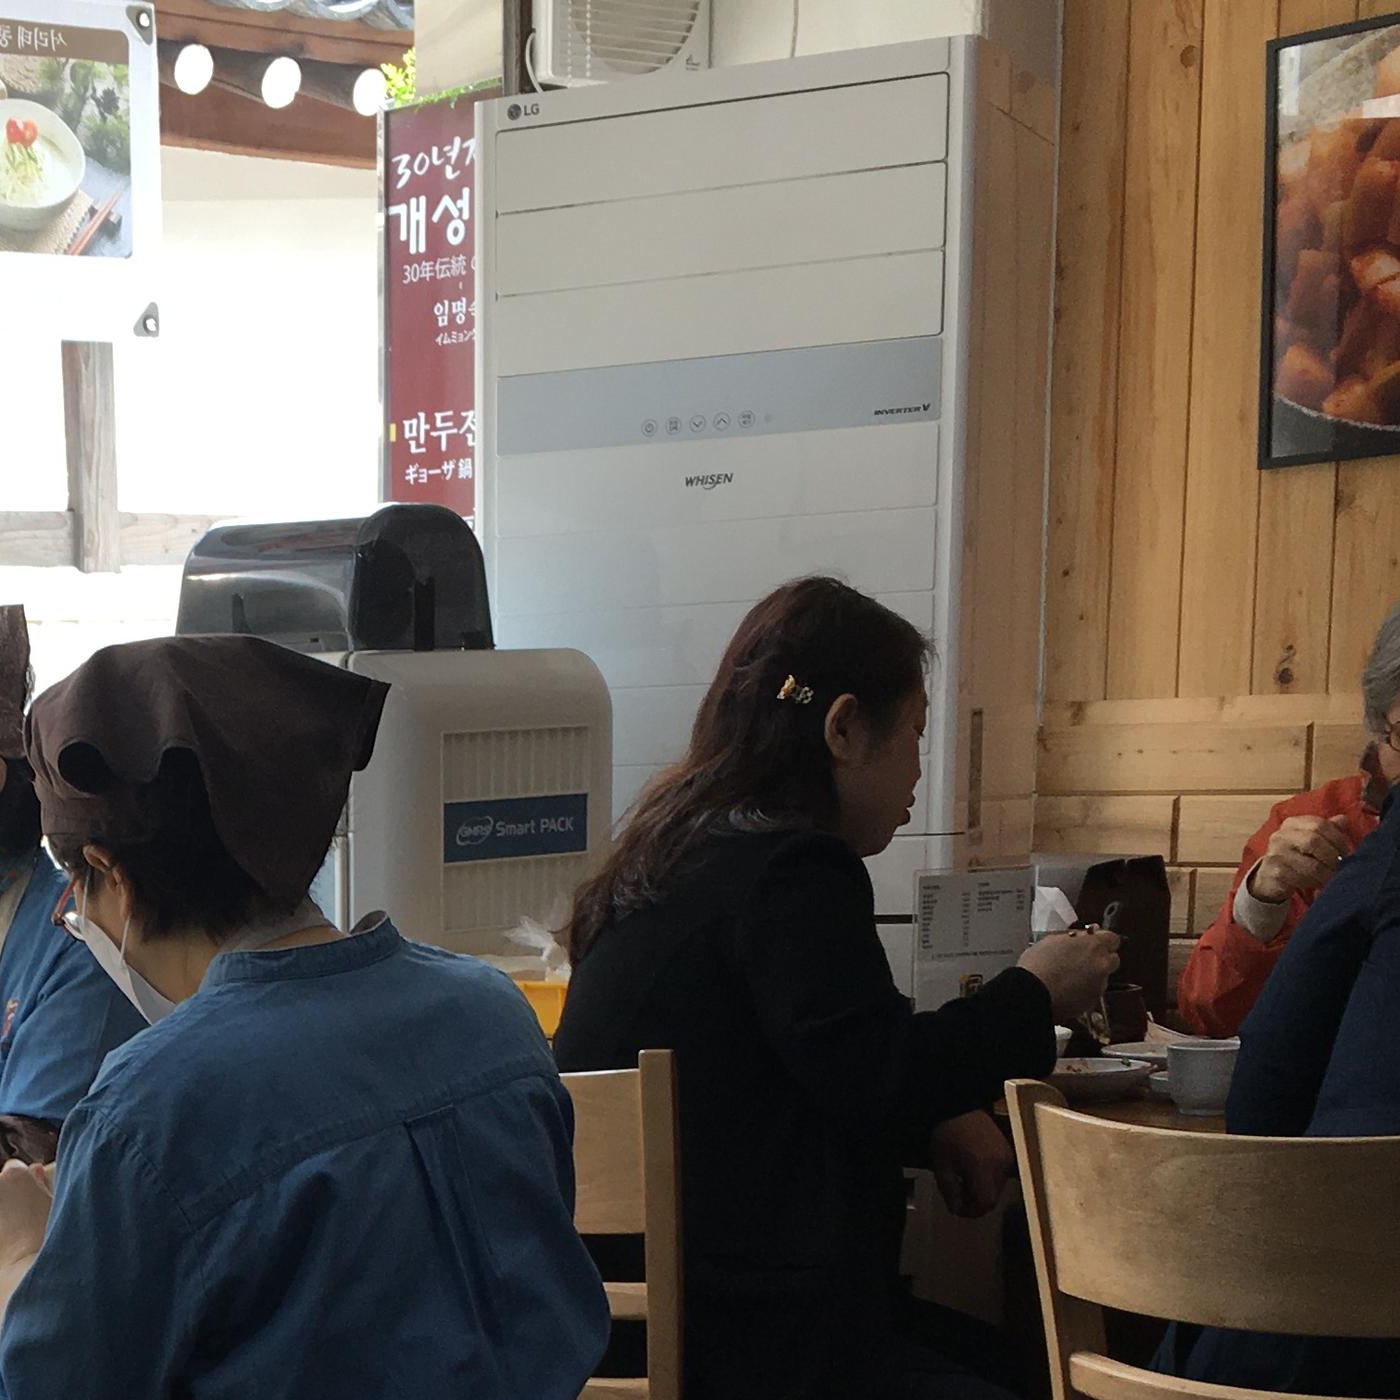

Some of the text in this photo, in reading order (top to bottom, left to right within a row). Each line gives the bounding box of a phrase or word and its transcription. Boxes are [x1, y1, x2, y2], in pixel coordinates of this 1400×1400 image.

[523, 103, 540, 116] LG
[388, 187, 470, 255] 개성
[402, 254, 467, 285] 30年伝統
[685, 473, 733, 490] WHISEN
[495, 820, 536, 837] Smart
[539, 816, 574, 833] PACK
